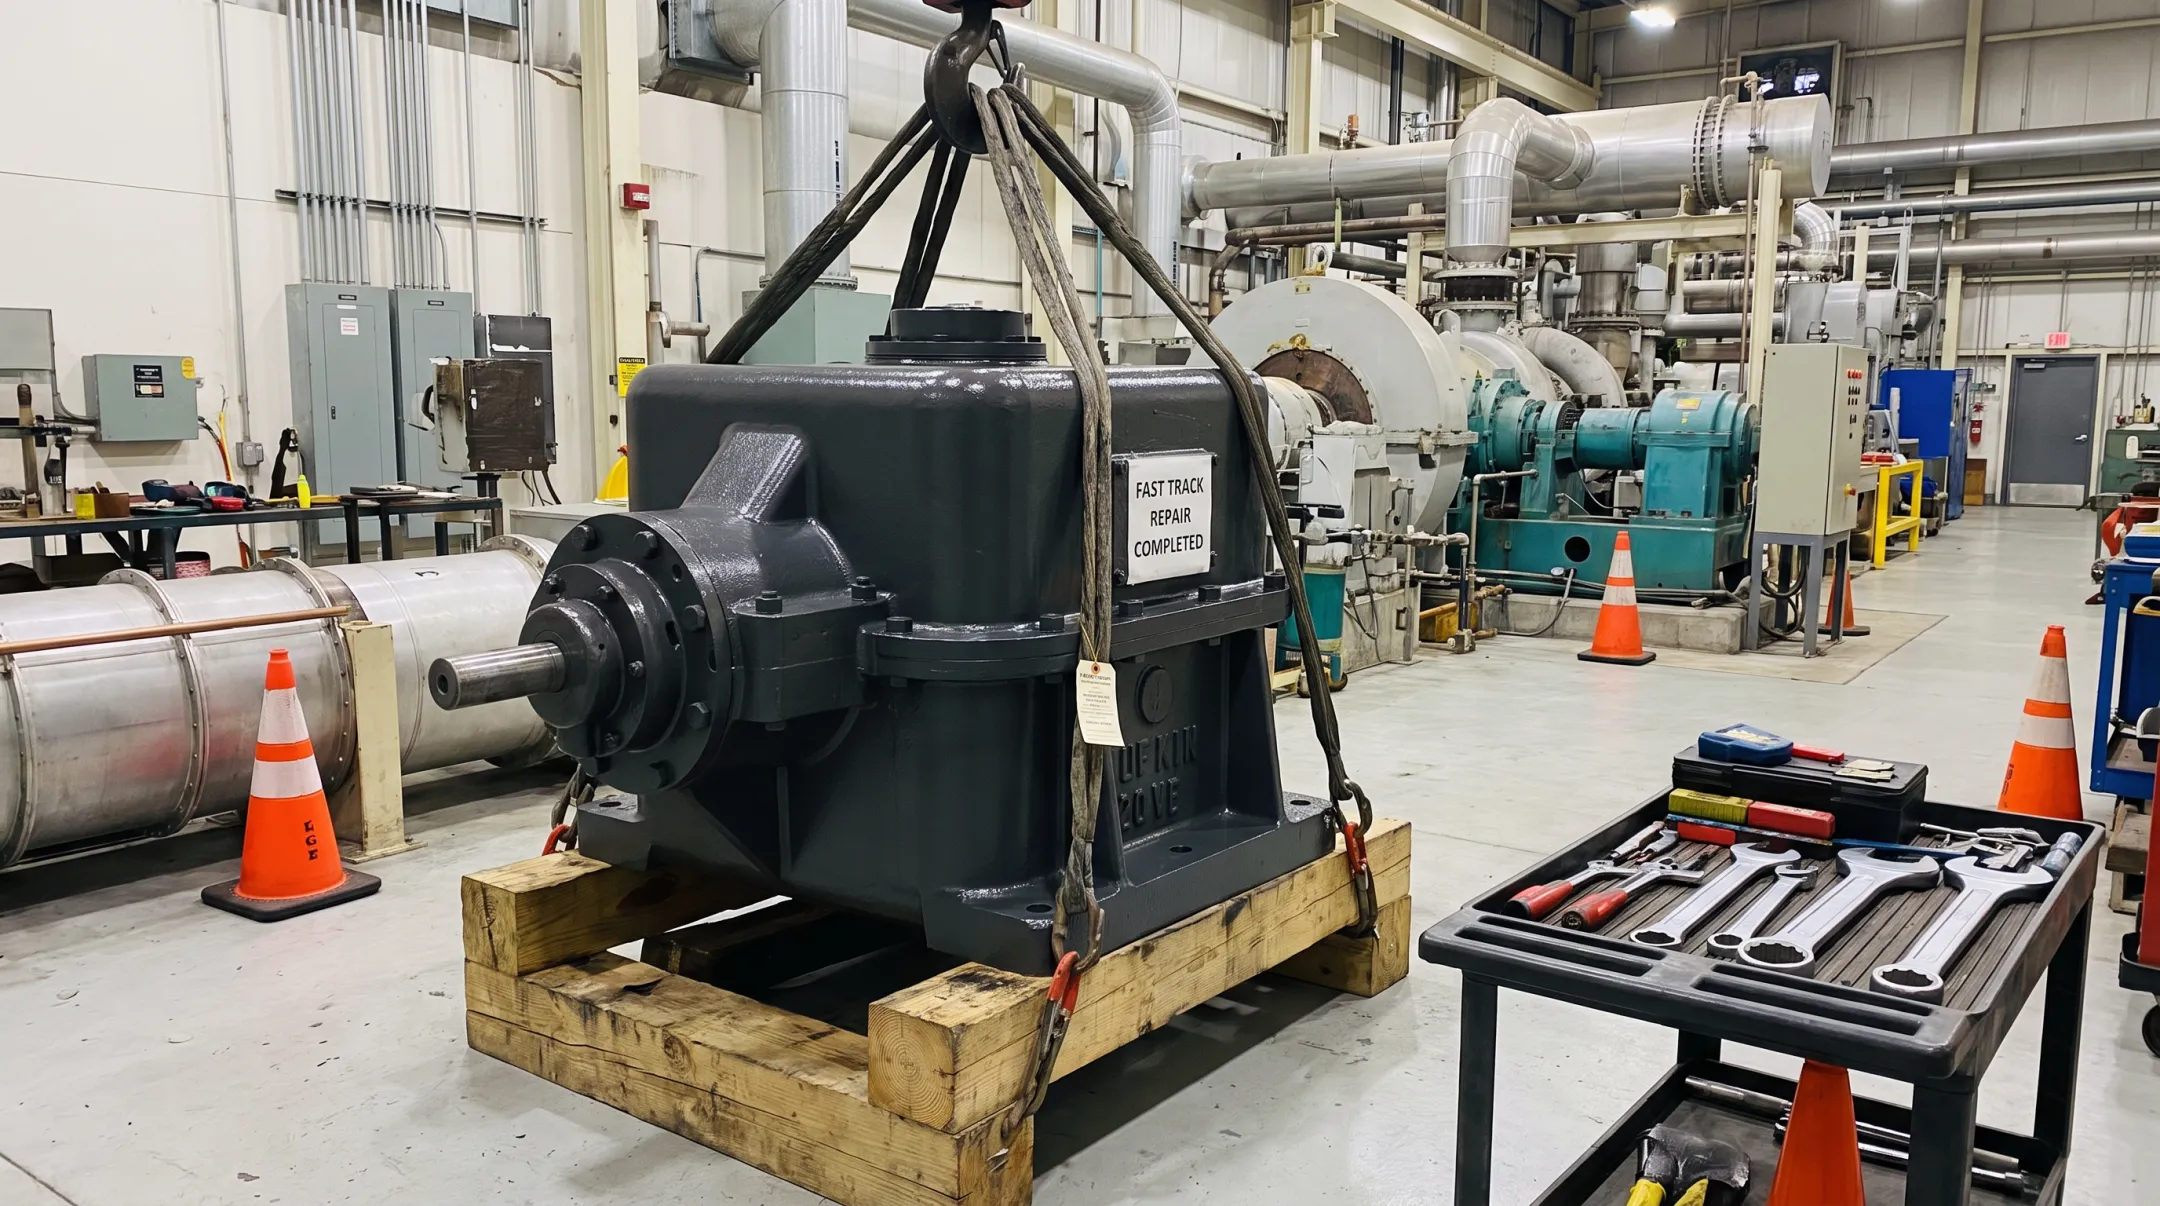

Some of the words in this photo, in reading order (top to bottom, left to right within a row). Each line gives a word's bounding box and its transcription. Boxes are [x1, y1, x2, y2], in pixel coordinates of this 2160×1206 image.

[1136, 480, 1165, 499] FAST
[1167, 477, 1204, 496] TRACK
[1150, 507, 1192, 527] REPAIR
[1134, 533, 1204, 558] COMPLETED
[1118, 725, 1198, 784] UFKIN
